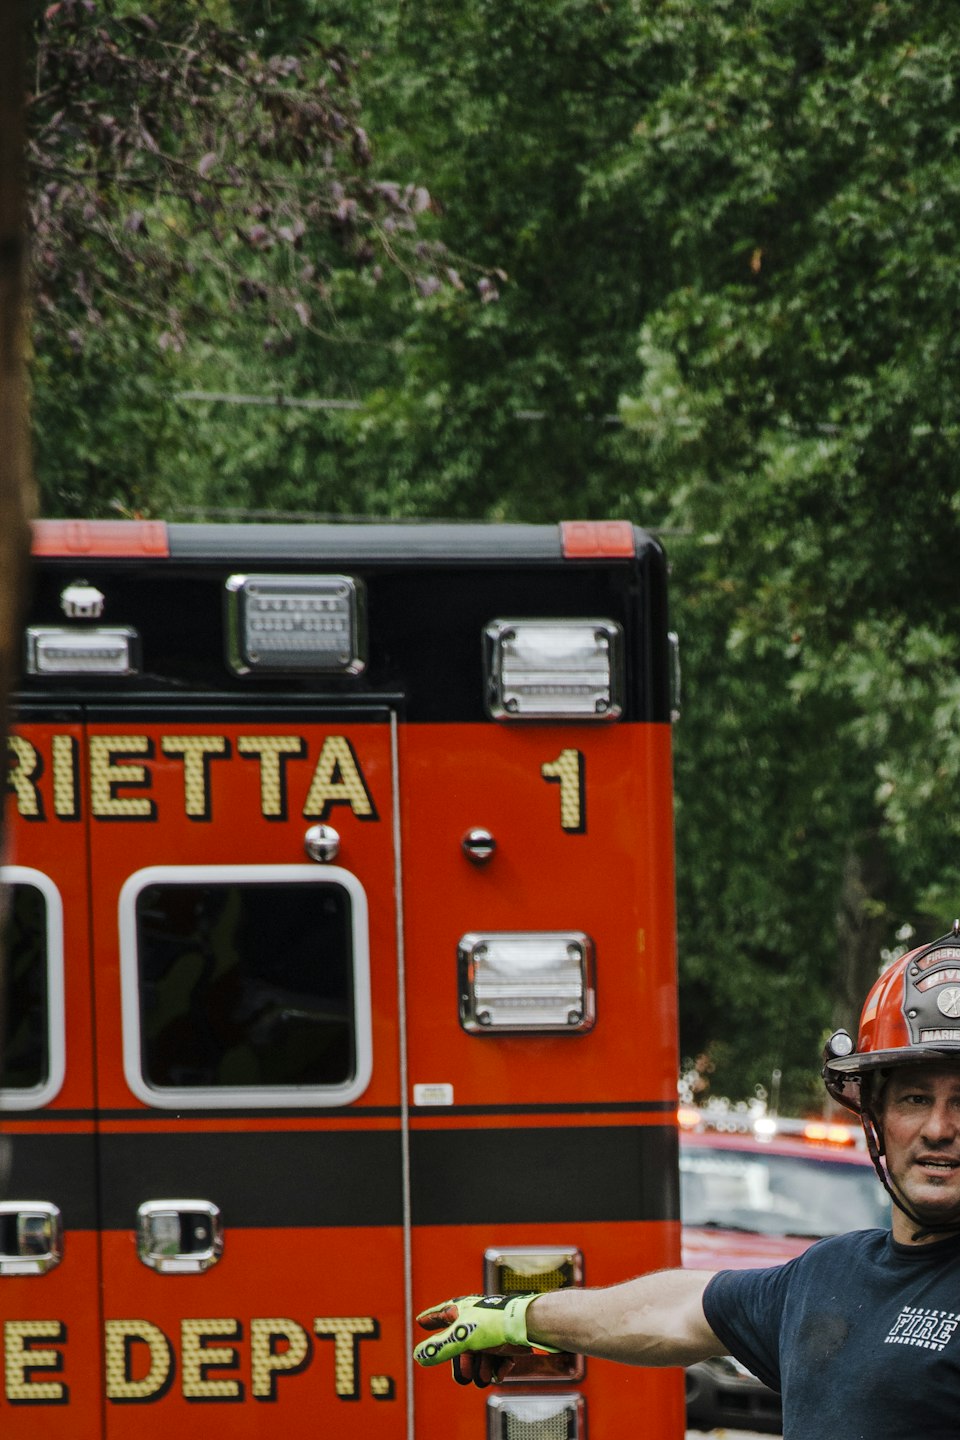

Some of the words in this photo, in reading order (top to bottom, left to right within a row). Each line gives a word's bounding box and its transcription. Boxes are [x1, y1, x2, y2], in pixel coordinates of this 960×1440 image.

[7, 735, 379, 822] RIETTA
[540, 748, 588, 833] 1
[888, 1313, 958, 1344] FIRE
[903, 1306, 960, 1321] MARIETTA
[105, 1316, 398, 1404] DEPT.
[884, 1337, 945, 1351] DEPARTMENT
